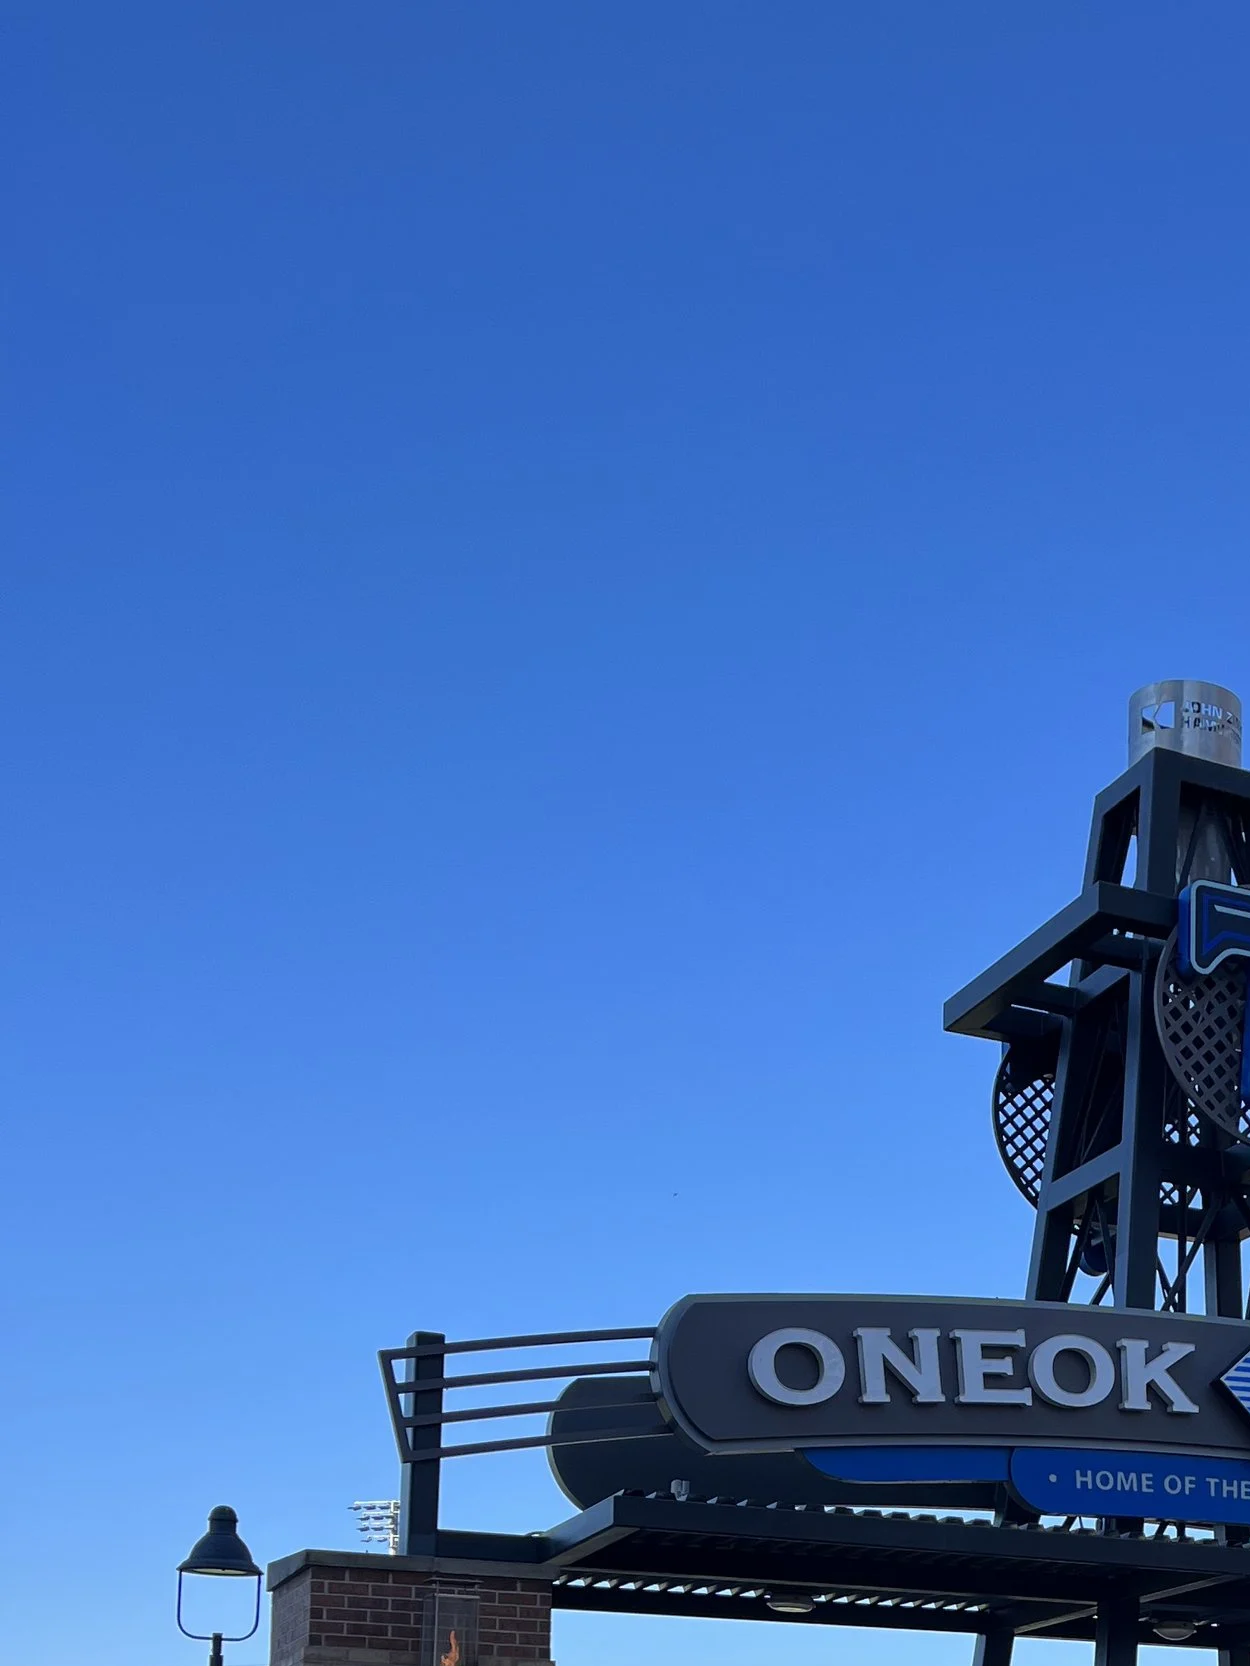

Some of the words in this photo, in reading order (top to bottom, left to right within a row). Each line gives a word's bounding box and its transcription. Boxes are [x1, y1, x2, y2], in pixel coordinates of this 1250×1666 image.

[747, 1327, 1199, 1416] ONEOK
[1075, 1469, 1154, 1494] HOME
[1163, 1474, 1197, 1496] OF
